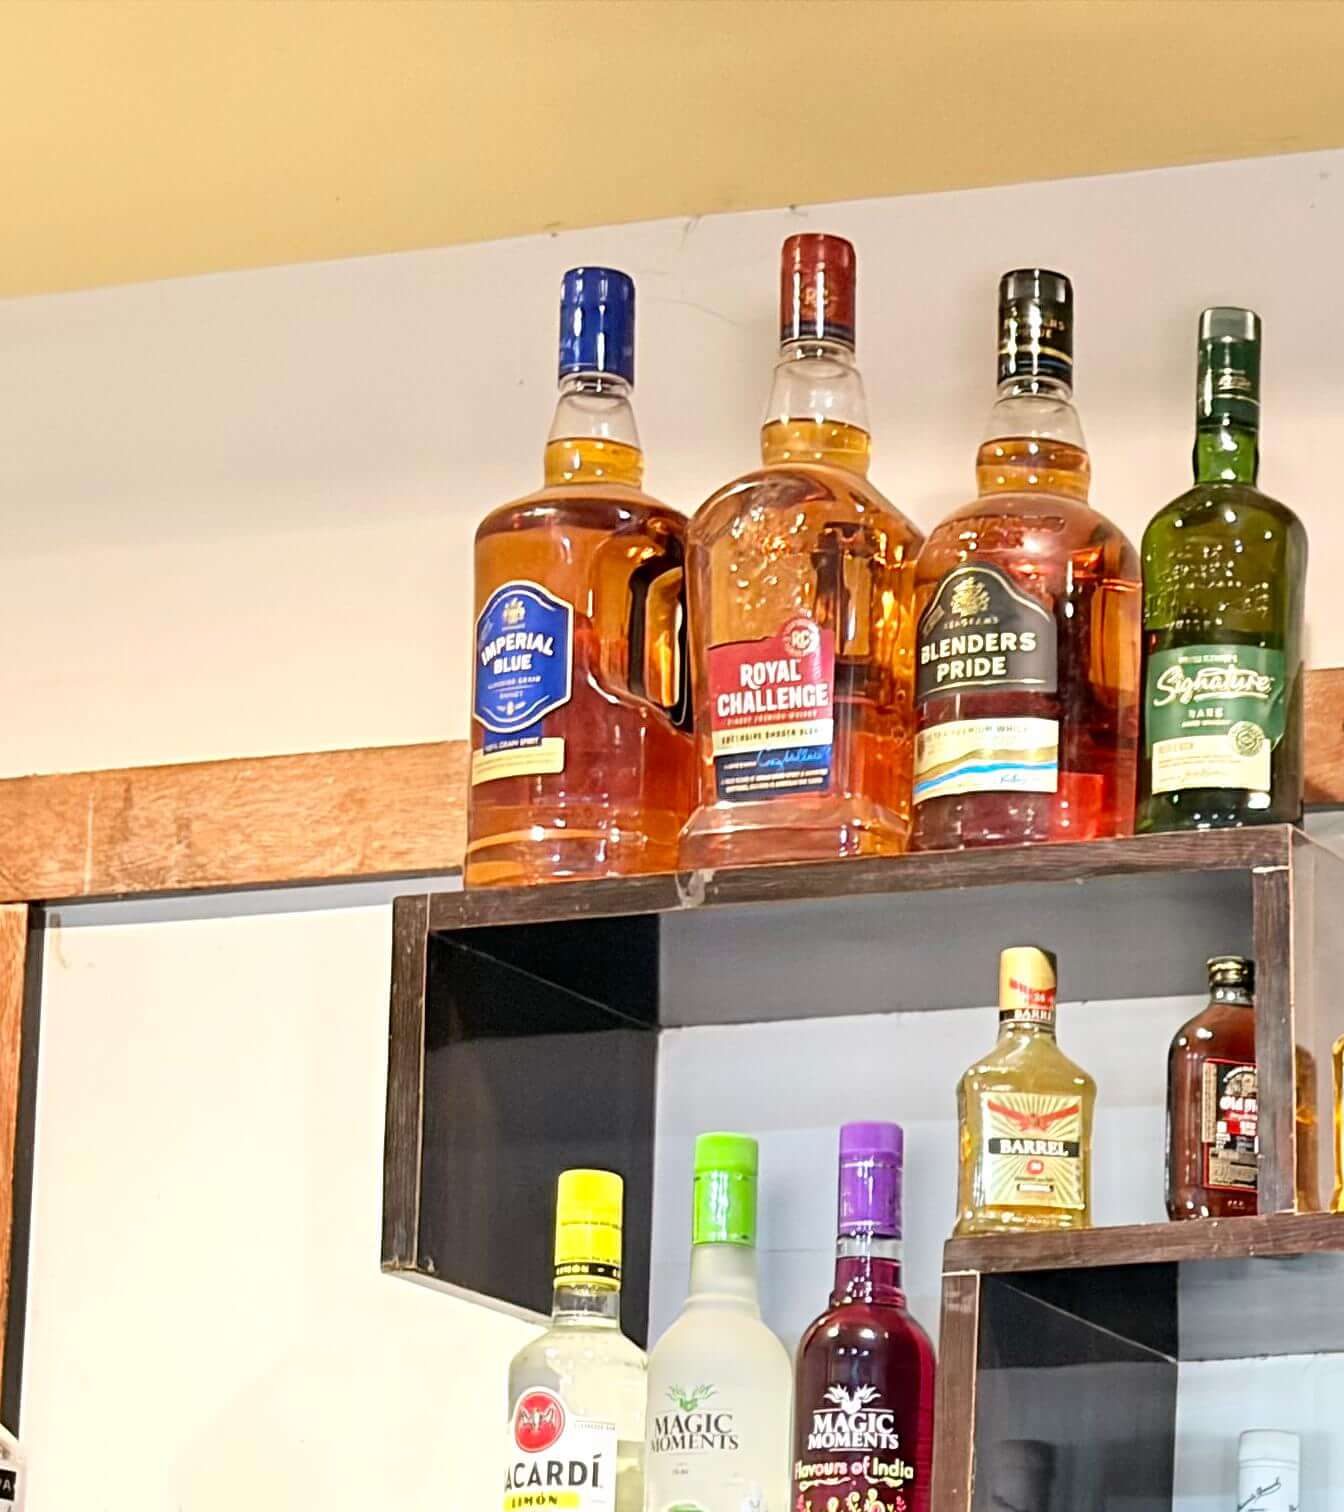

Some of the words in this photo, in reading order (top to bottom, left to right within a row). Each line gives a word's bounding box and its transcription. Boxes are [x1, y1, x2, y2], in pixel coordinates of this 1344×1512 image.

[481, 632, 554, 666] IMPERIAL
[920, 632, 1037, 665] BLENDERS
[493, 654, 532, 675] BLUE
[740, 659, 802, 690] ROYAL
[936, 656, 1007, 683] PRIDE
[1153, 664, 1275, 707] Signature
[717, 683, 829, 718] CHALLENGE
[999, 1138, 1070, 1157] BARREL
[655, 1413, 733, 1435] MAGIC
[813, 1413, 895, 1434] MAGIC
[651, 1433, 739, 1453] MOMENTS
[807, 1432, 899, 1451] MOMENTS
[505, 1453, 602, 1492] ACARDÍ
[851, 1456, 870, 1479] of
[872, 1457, 914, 1479] India
[511, 1491, 558, 1508] LIMÓN
